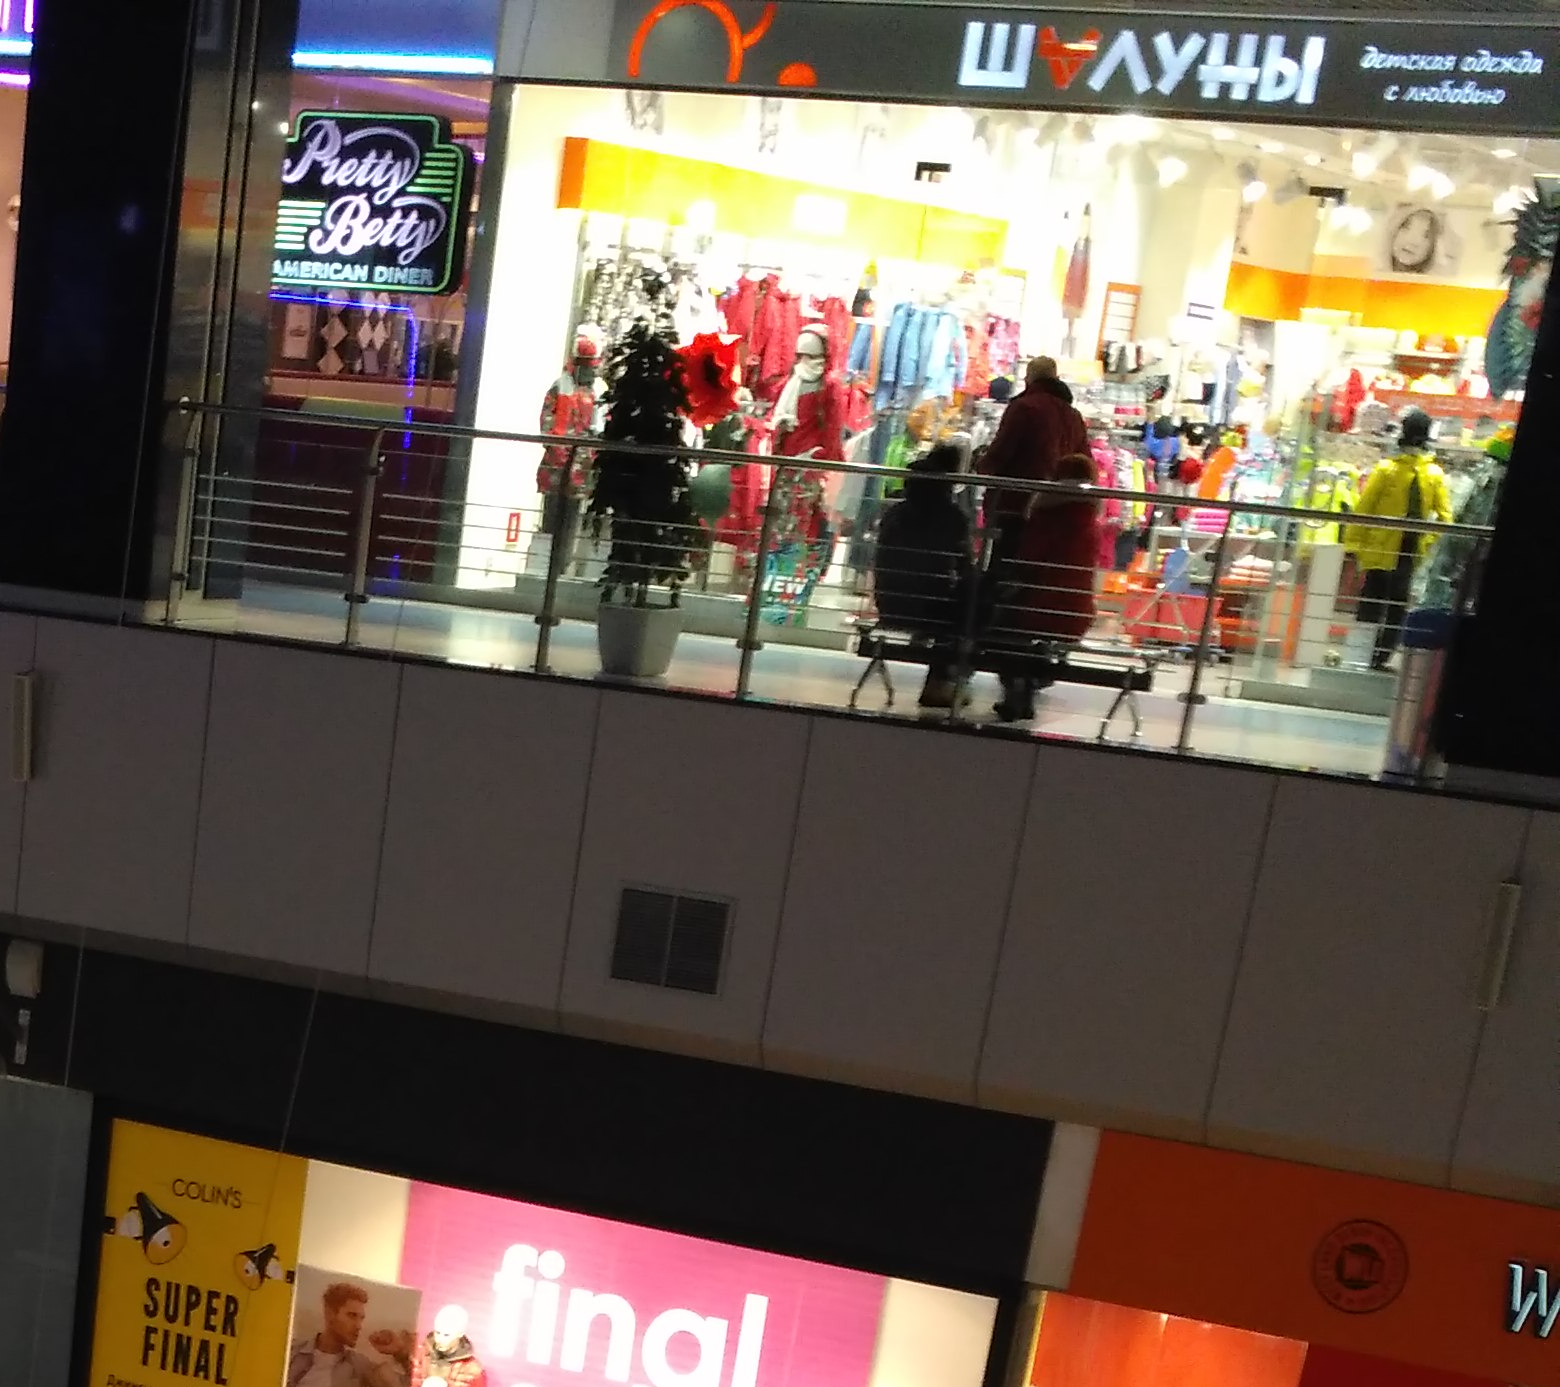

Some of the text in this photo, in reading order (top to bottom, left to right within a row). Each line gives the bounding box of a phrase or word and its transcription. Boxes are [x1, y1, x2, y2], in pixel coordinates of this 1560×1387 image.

[957, 21, 1327, 104] ШАЛУНЫ
[282, 119, 420, 205] Pretty
[308, 193, 447, 265] Betty
[272, 259, 434, 285] AMERICAN DINER
[172, 1178, 243, 1209] COLIN'S
[143, 1276, 239, 1338] SUPER
[142, 1325, 228, 1386] FINAL
